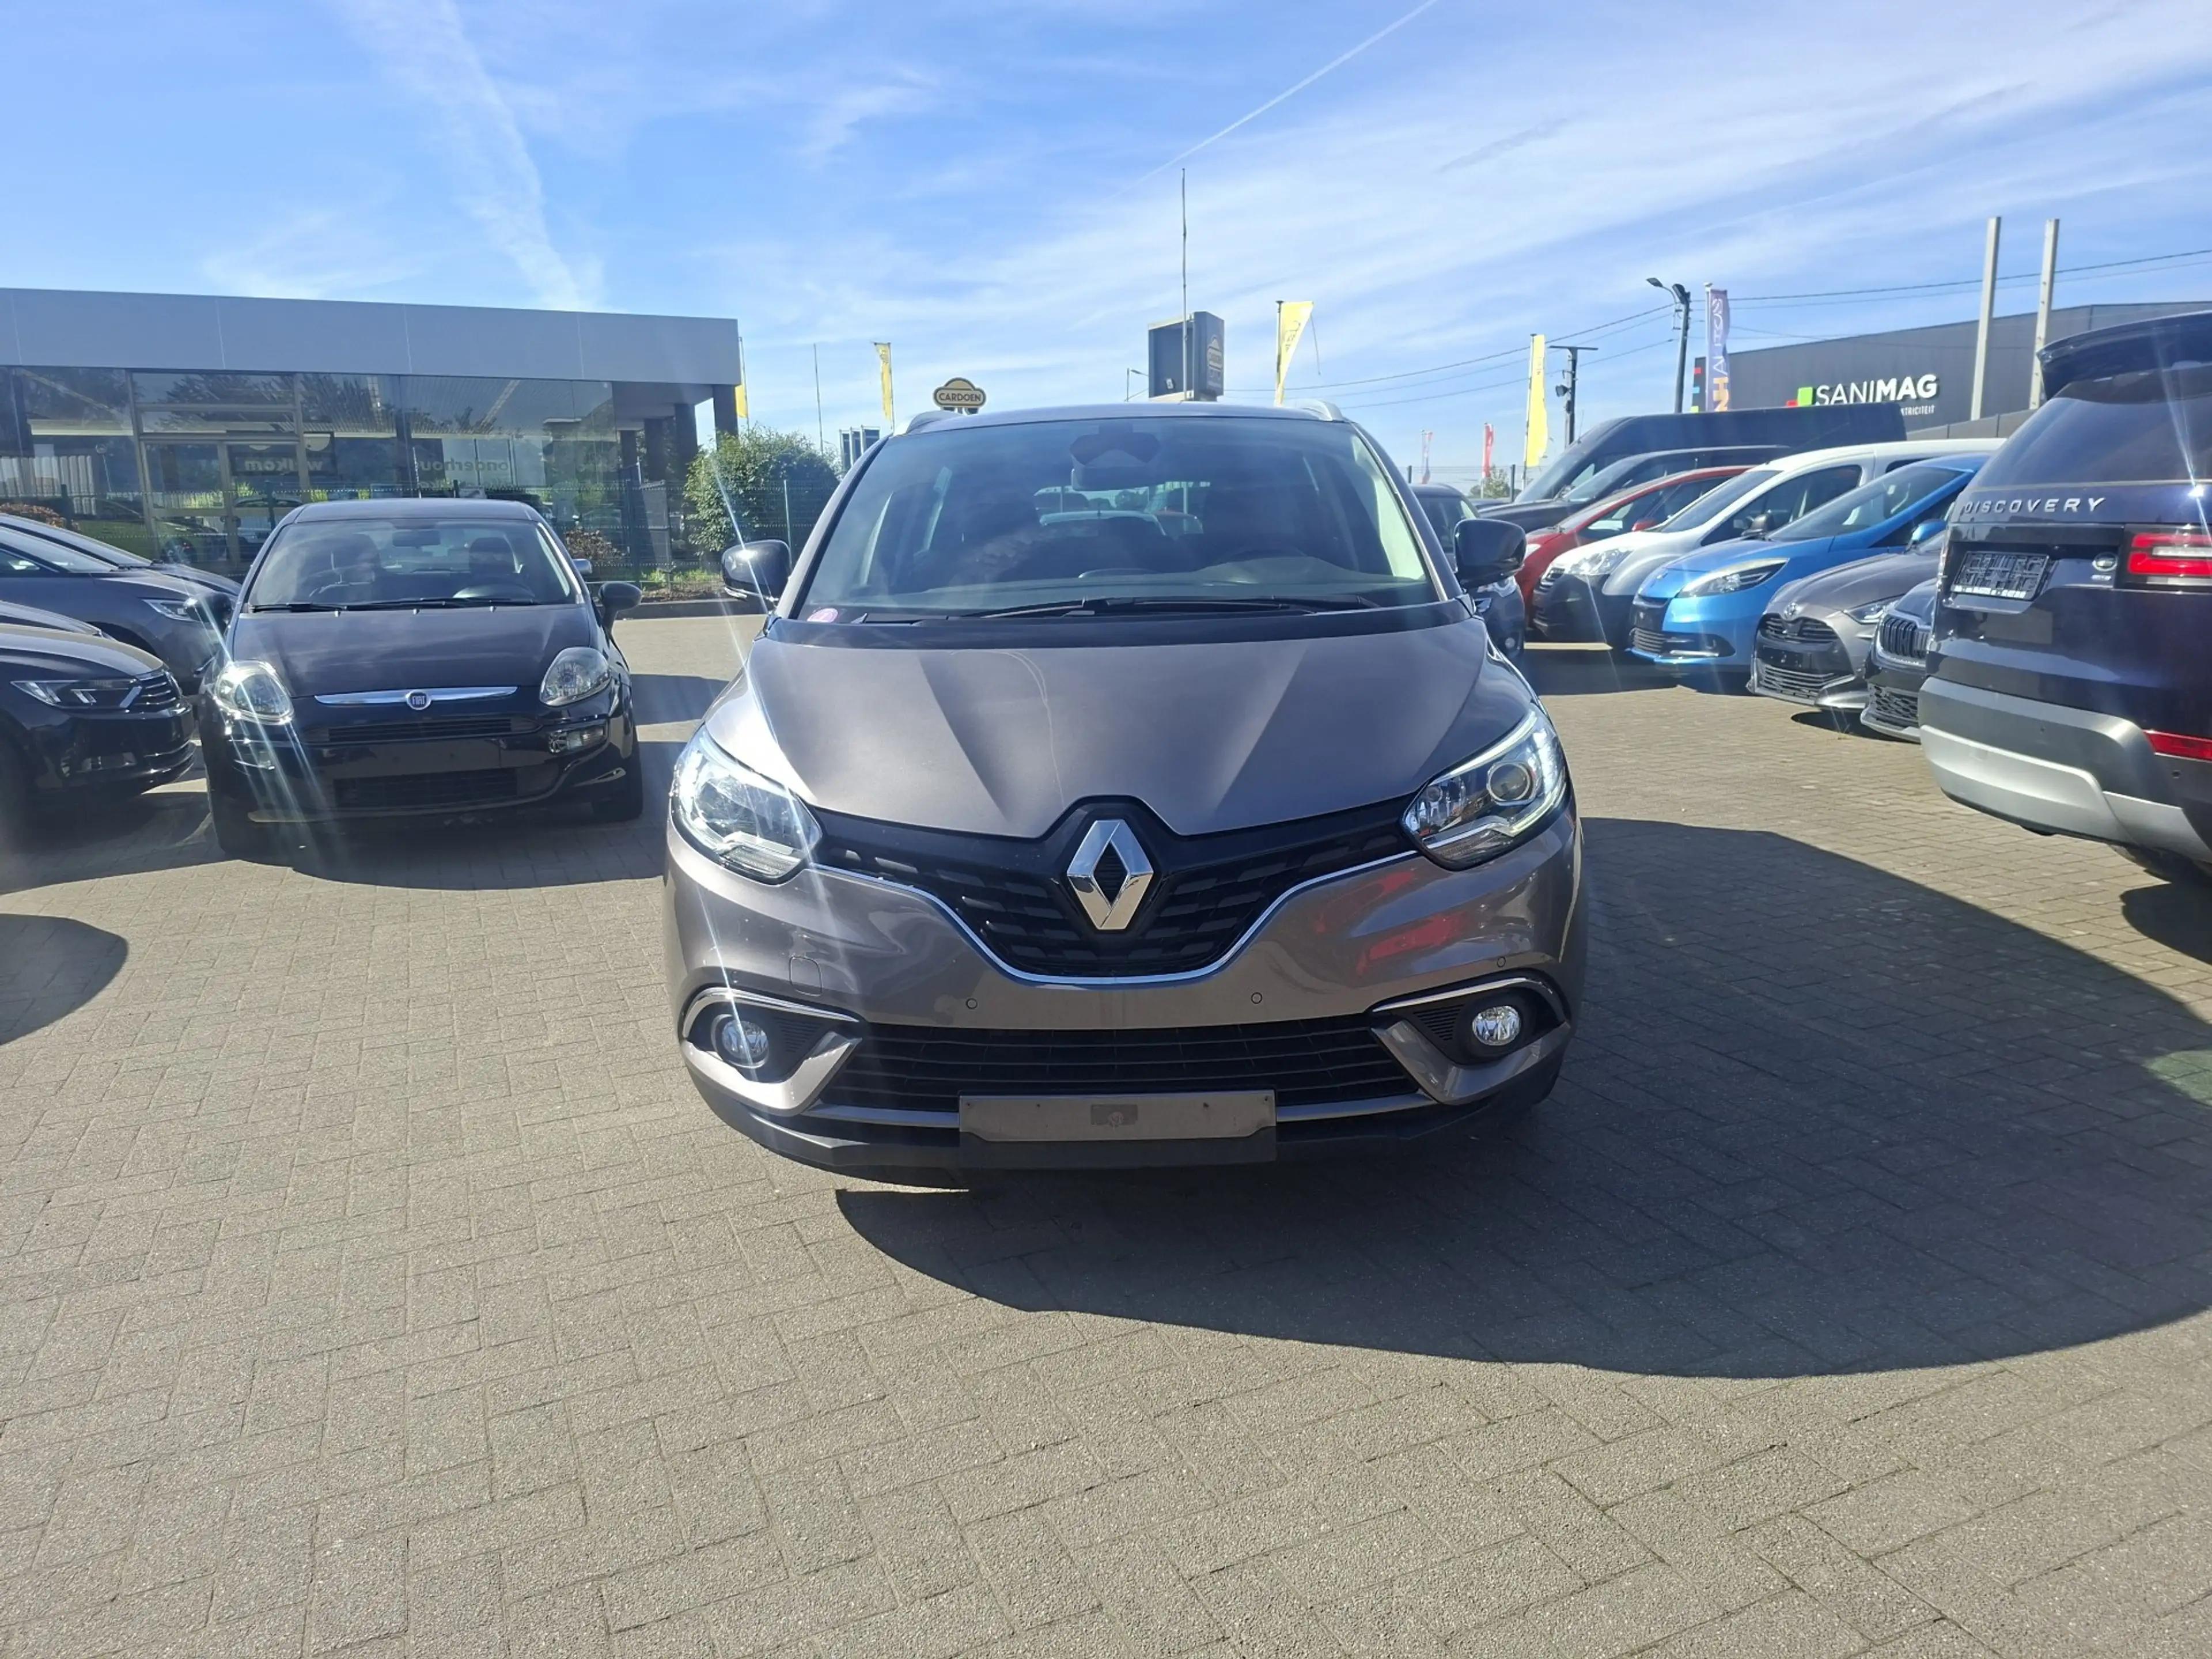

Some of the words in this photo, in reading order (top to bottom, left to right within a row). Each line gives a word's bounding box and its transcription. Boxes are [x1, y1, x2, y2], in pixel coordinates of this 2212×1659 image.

[1815, 374, 1937, 406] SANIMAG
[938, 392, 982, 402] CARDOEN
[1964, 498, 2105, 514] DISCOVERY
[412, 696, 425, 705] FIAT
